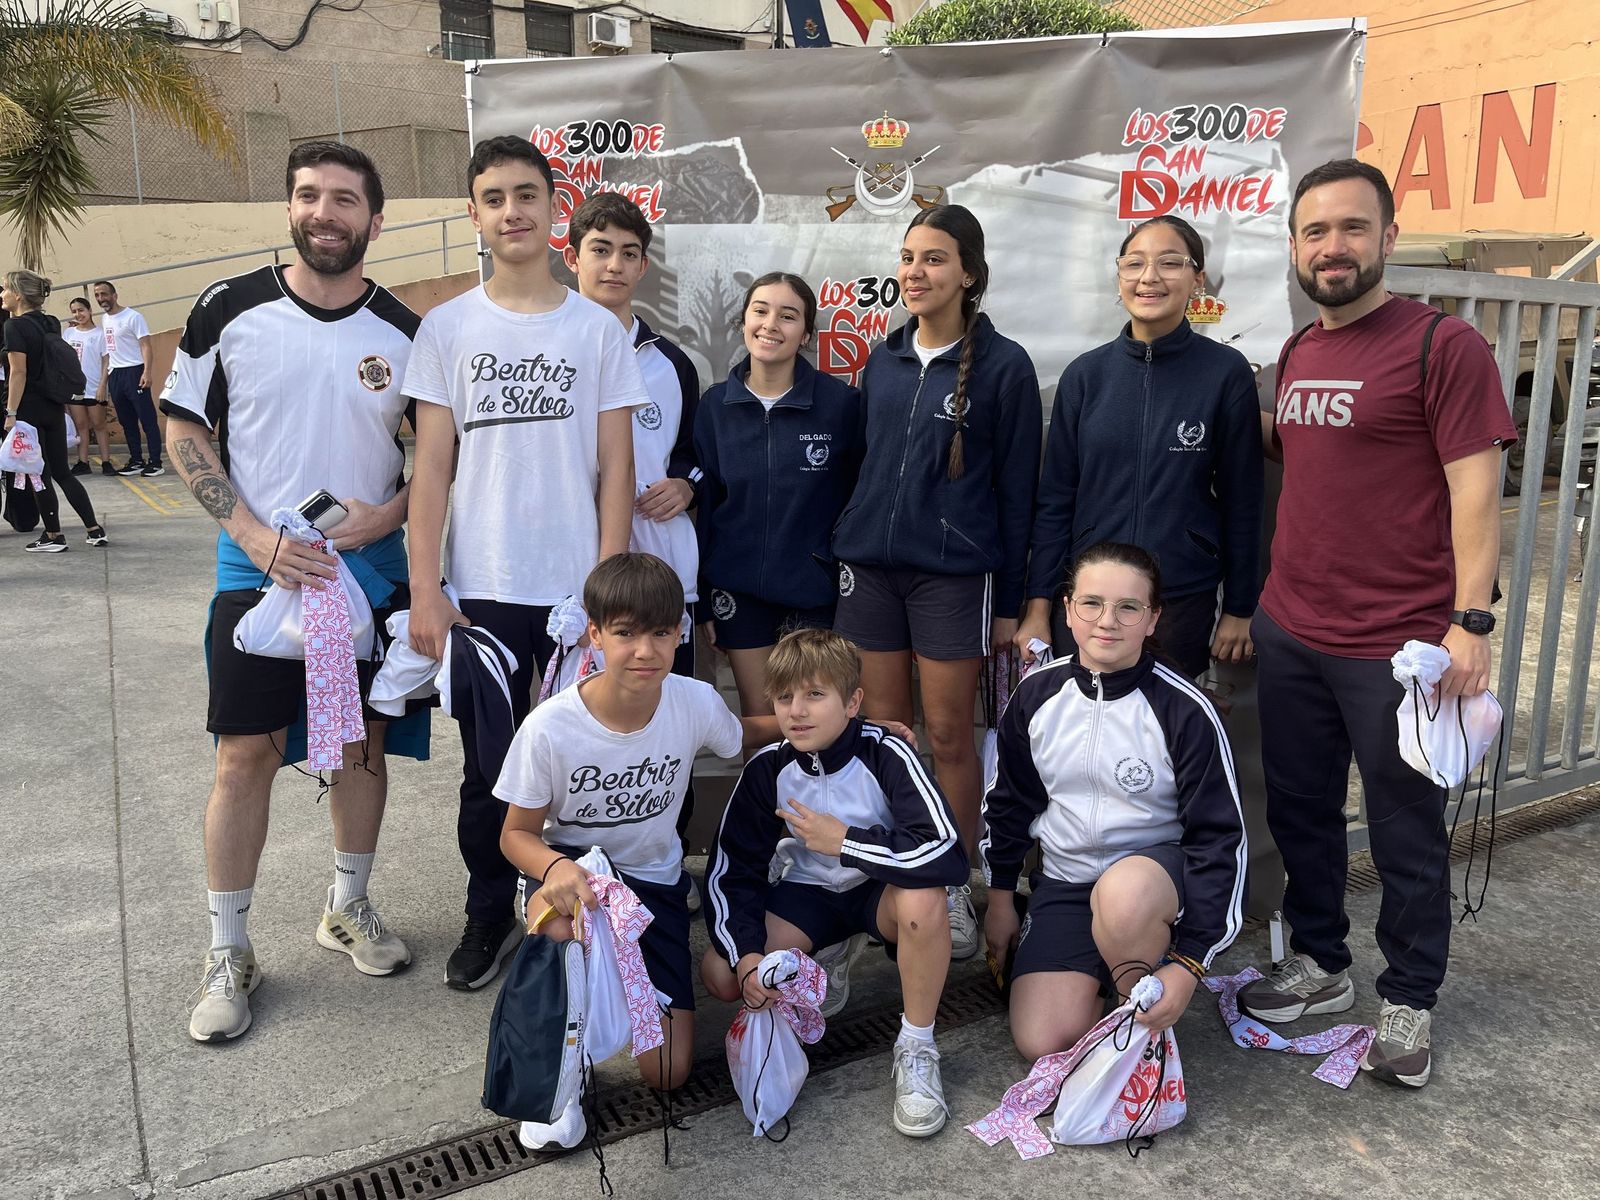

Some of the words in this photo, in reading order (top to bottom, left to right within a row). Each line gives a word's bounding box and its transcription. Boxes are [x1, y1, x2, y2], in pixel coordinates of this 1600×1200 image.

[1356, 82, 1556, 213] AN
[1118, 170, 1277, 222] DANIEL
[471, 353, 577, 393] Beatriz
[477, 394, 498, 413] de
[501, 385, 575, 416] Silva
[1276, 380, 1364, 428] VANS
[799, 433, 833, 441] DELGADO
[569, 754, 682, 795] Beatriz
[575, 802, 599, 818] de
[605, 788, 676, 819] Silva
